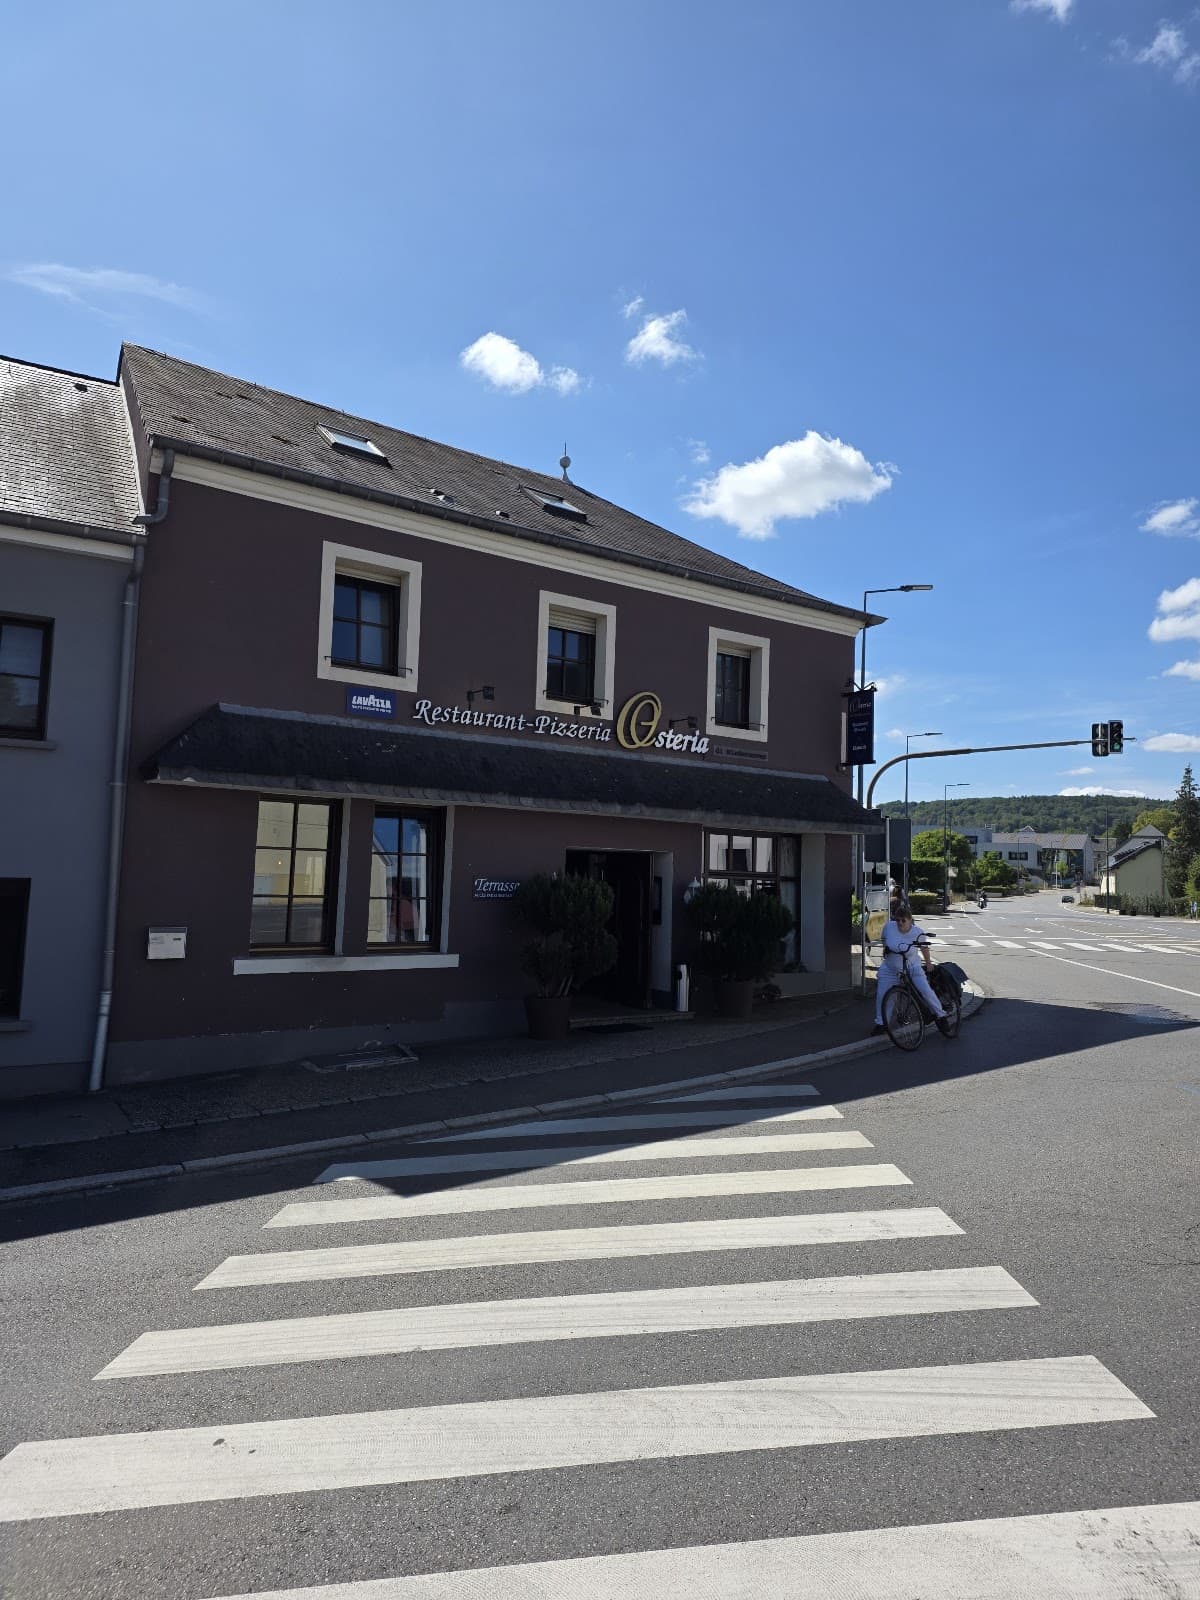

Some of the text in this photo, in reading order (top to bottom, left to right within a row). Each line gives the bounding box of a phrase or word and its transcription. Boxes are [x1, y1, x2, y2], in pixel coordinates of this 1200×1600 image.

[352, 695, 391, 709] LAVAZZA
[413, 691, 710, 754] Restaurant-Pizzeria Osteria
